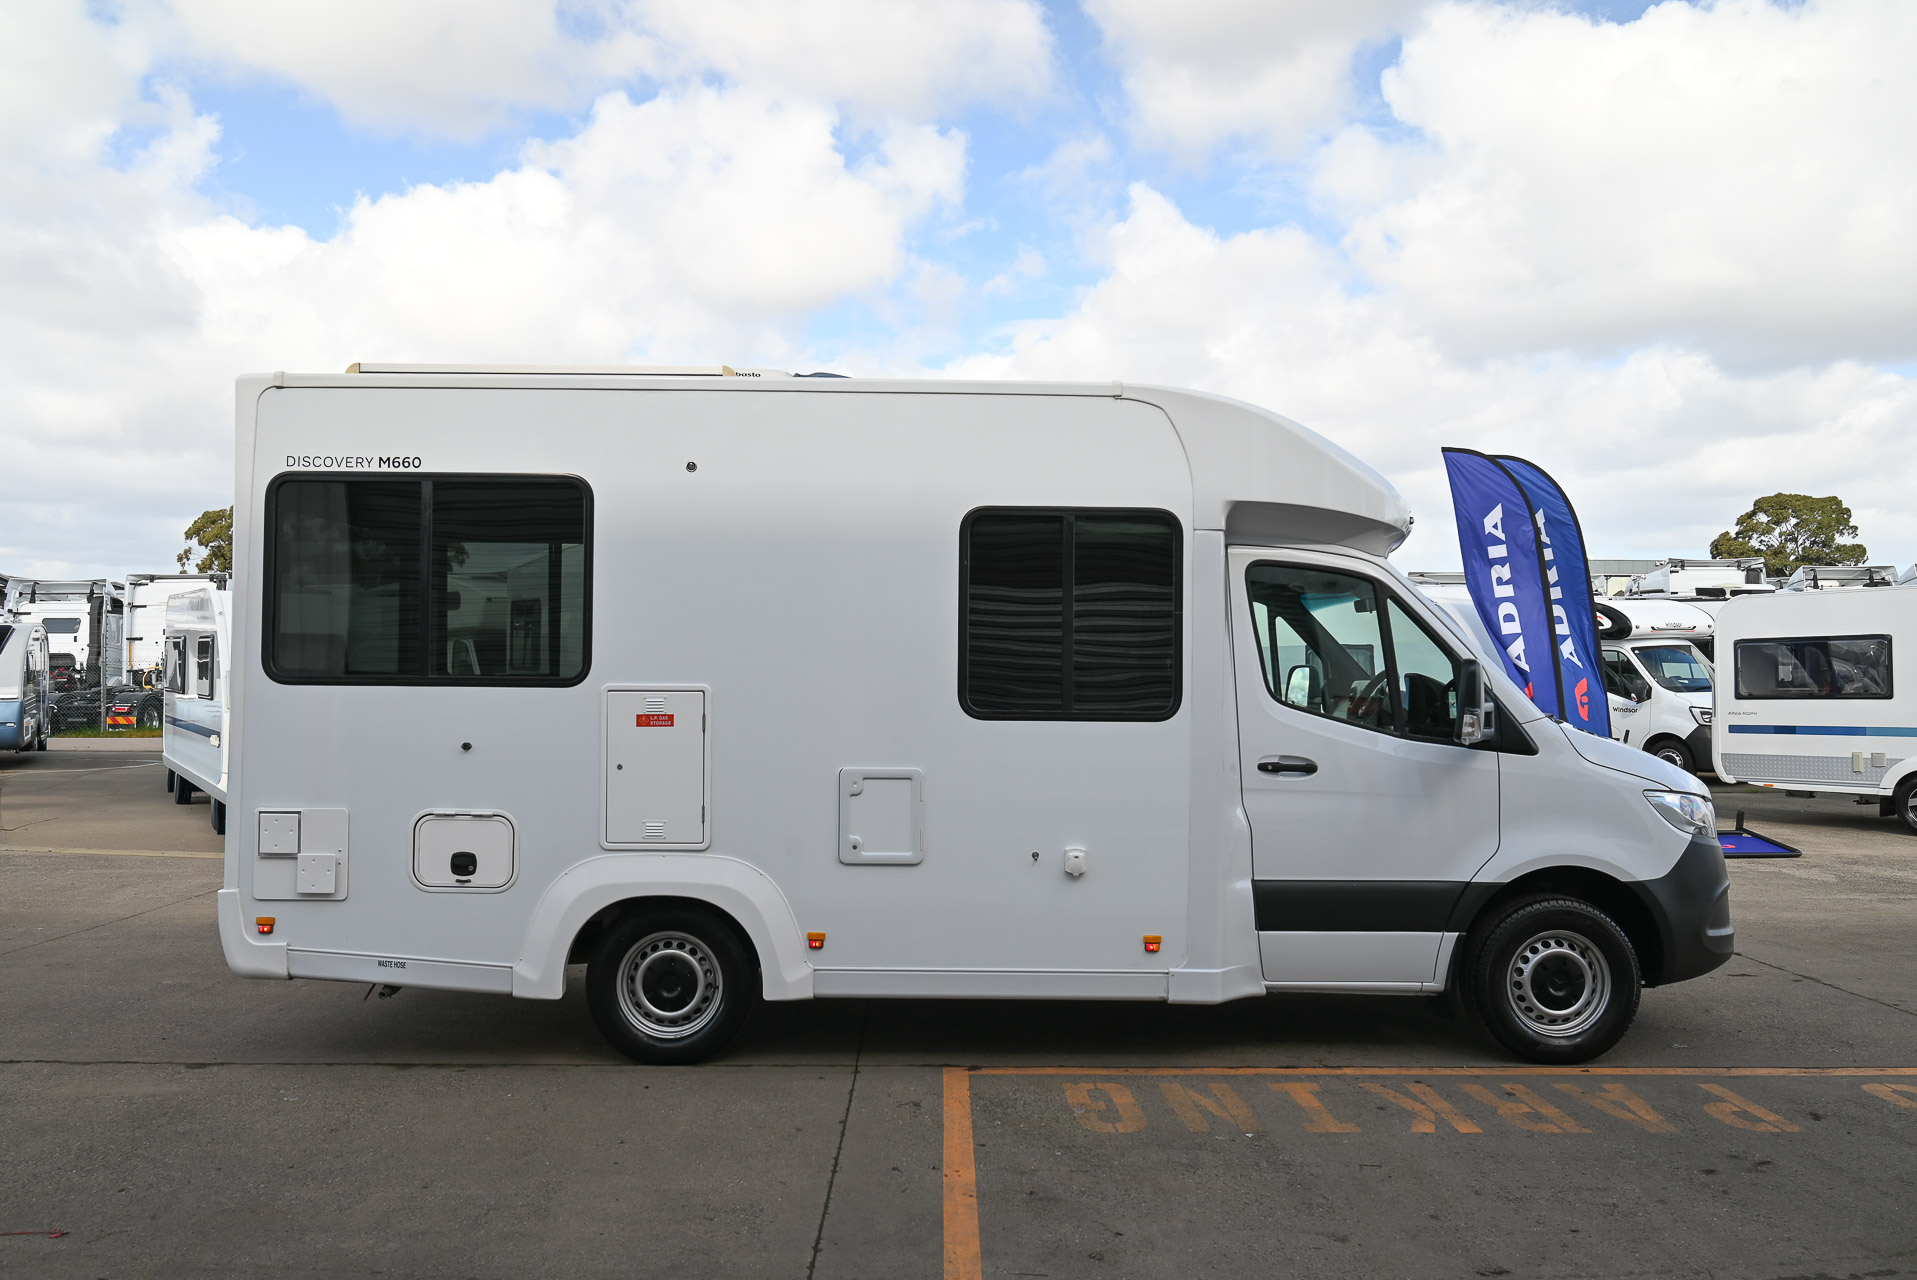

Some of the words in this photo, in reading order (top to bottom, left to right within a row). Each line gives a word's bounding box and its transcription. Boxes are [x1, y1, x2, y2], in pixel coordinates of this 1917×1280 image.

[286, 455, 374, 468] DISCOVERY
[378, 456, 422, 469] M660
[1483, 502, 1531, 673] ADRIA
[1612, 706, 1638, 714] Windsor
[377, 960, 393, 968] WASTE
[394, 961, 407, 969] HOSE
[1061, 1082, 1806, 1134] PARKING
